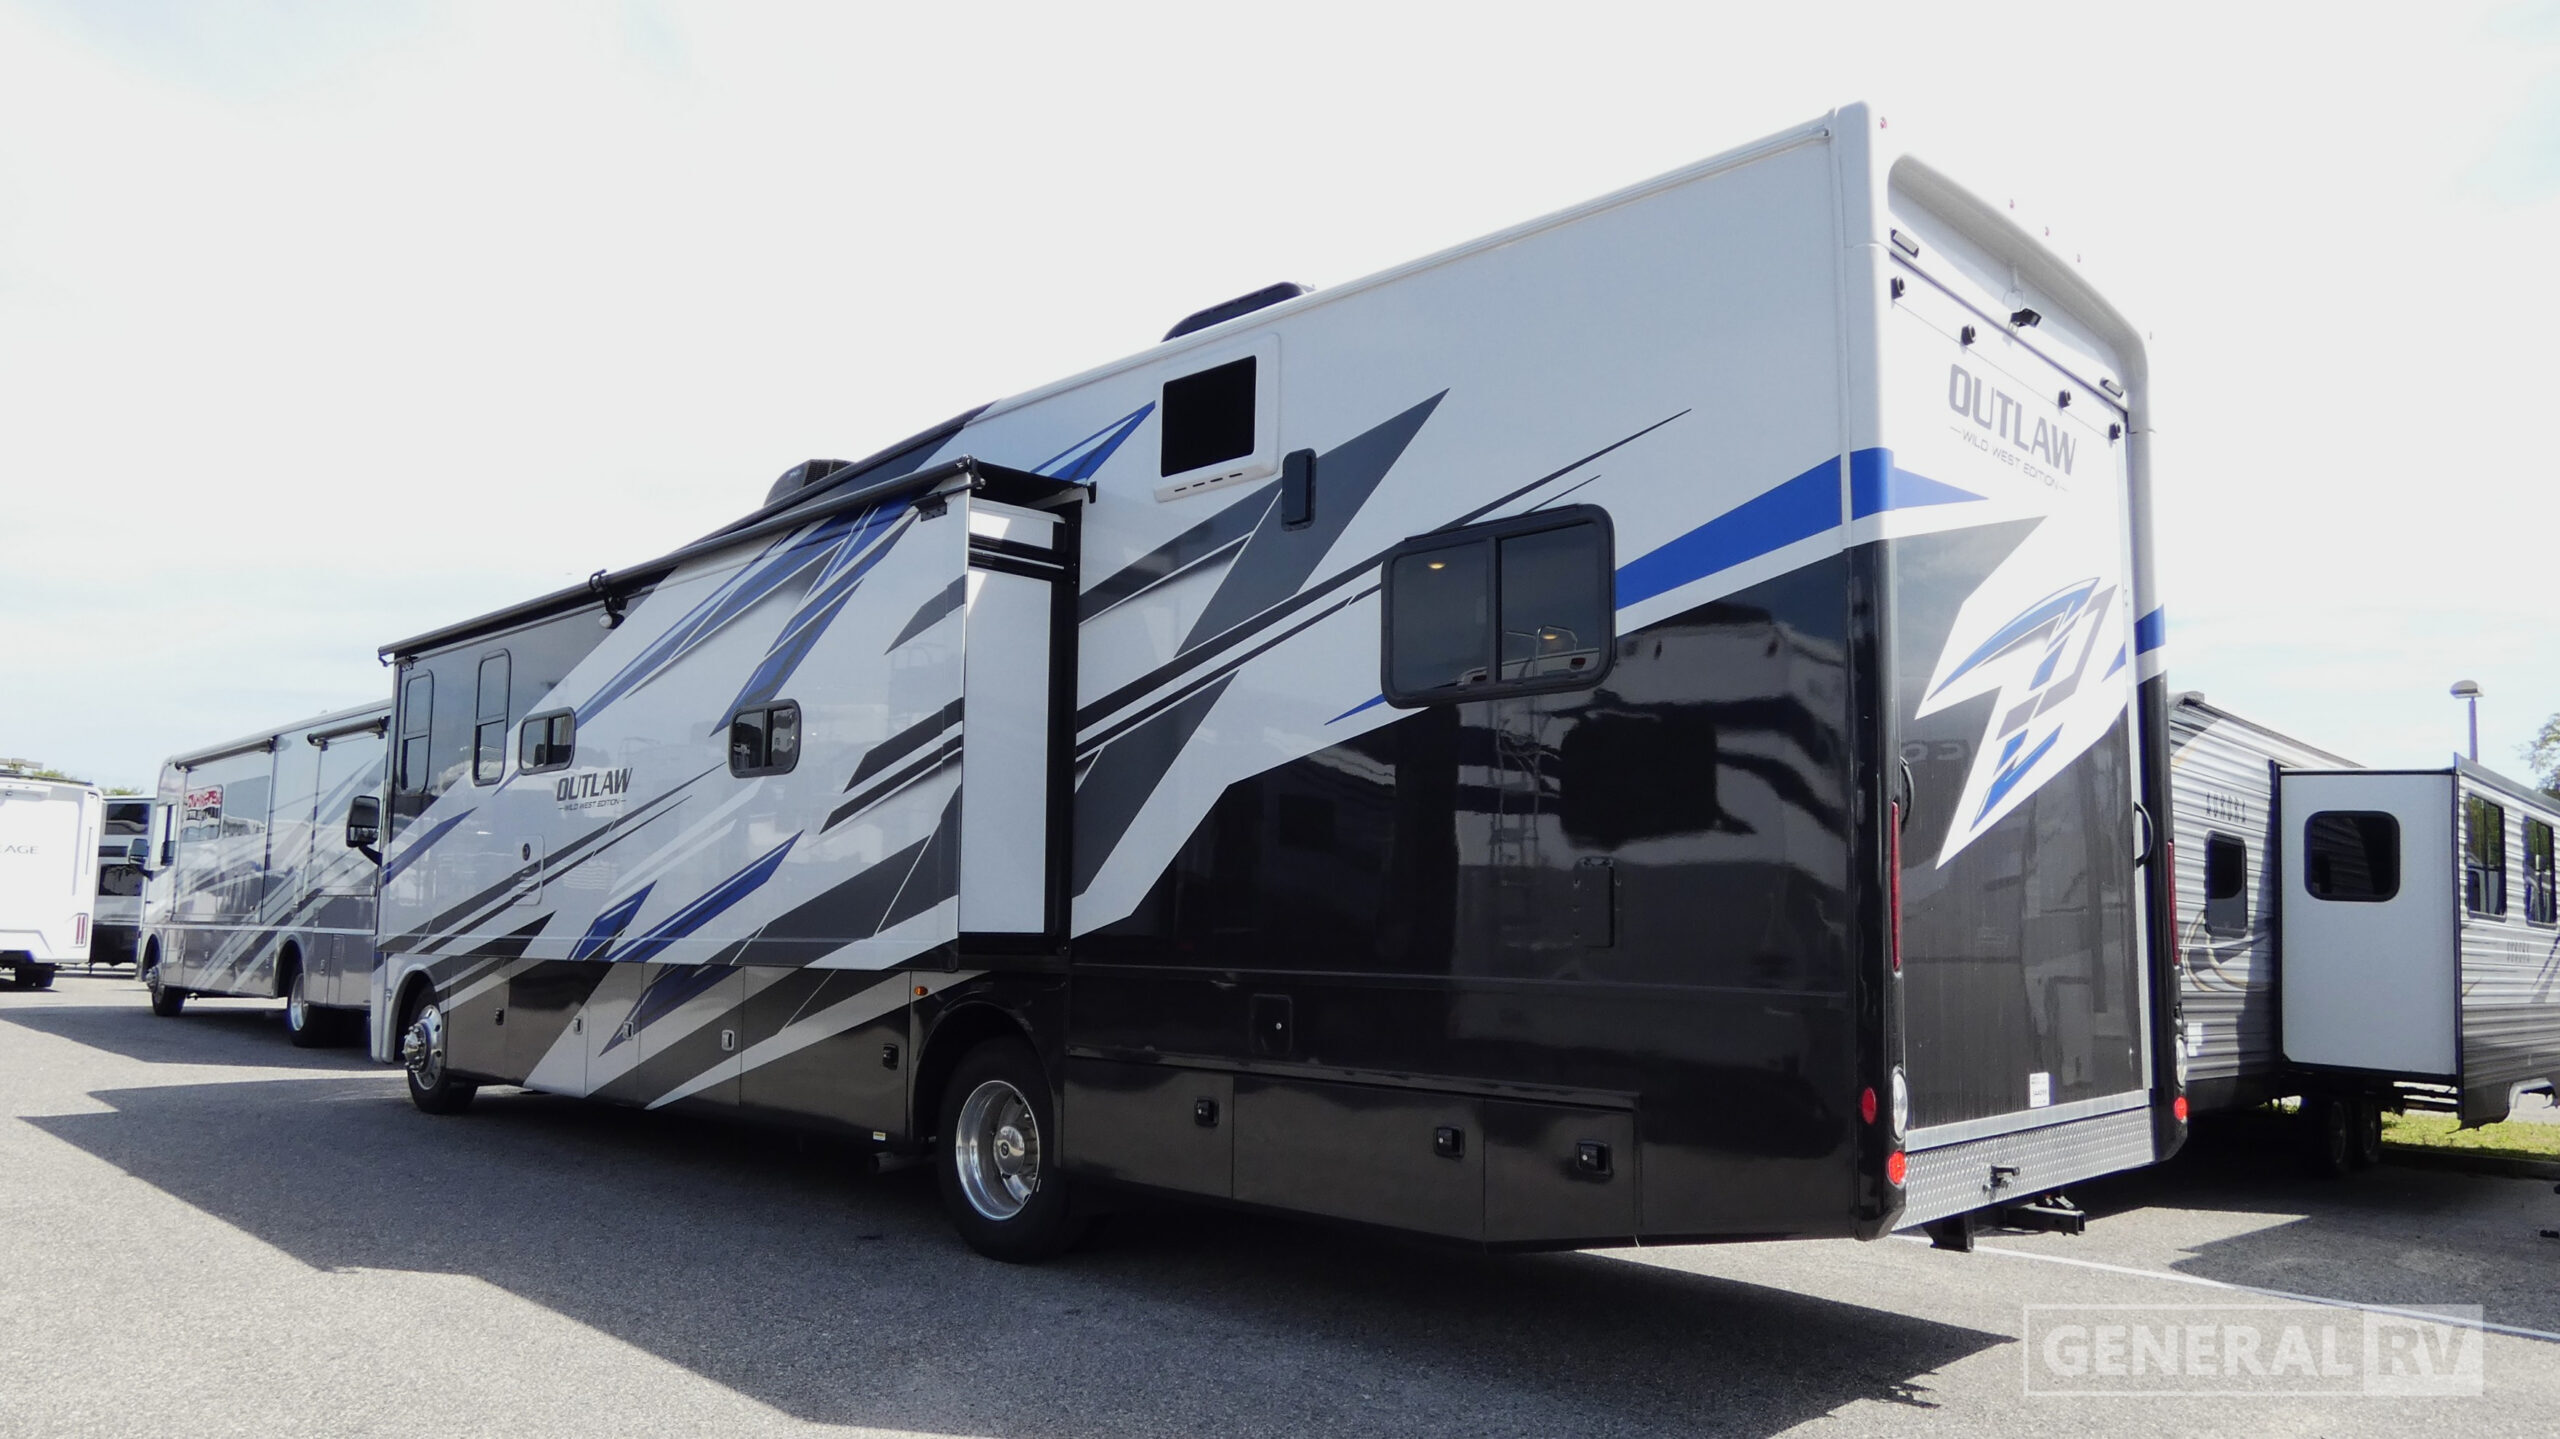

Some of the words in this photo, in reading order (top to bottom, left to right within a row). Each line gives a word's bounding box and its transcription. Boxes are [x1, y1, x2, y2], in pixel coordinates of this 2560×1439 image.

[1949, 363, 2077, 476] OUTLAW
[1963, 430, 1989, 452] WILD
[1992, 447, 2021, 468] WEST
[556, 768, 633, 801] OUTLAW
[565, 803, 579, 811] WILD
[579, 801, 597, 809] WEST
[597, 799, 620, 808] EDITION
